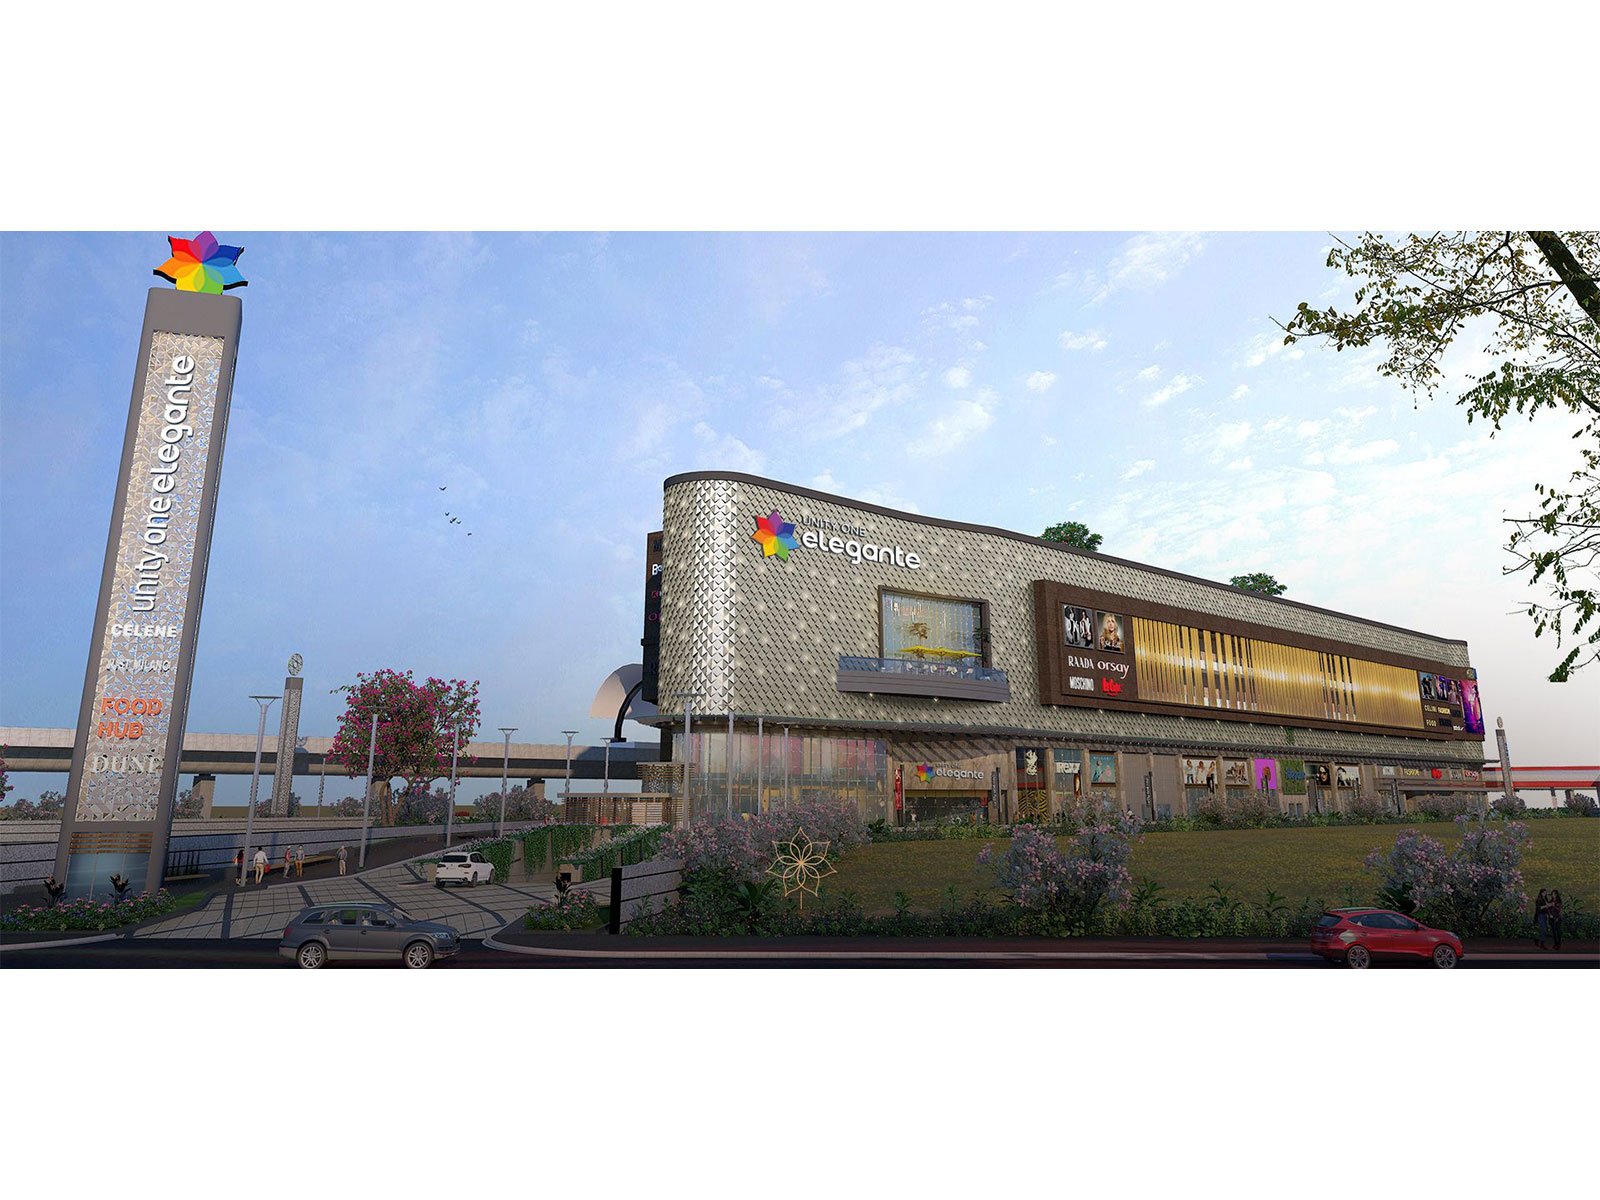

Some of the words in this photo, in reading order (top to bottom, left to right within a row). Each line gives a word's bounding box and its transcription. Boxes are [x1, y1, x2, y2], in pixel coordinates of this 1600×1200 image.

[801, 515, 838, 532] UNITY
[840, 523, 867, 538] ONE
[801, 529, 920, 569] elegante
[1068, 655, 1095, 669] RAADA
[1097, 660, 1130, 680] orsay
[101, 697, 163, 716] FOOD
[97, 721, 145, 739] HUB
[935, 768, 985, 781] elegante
